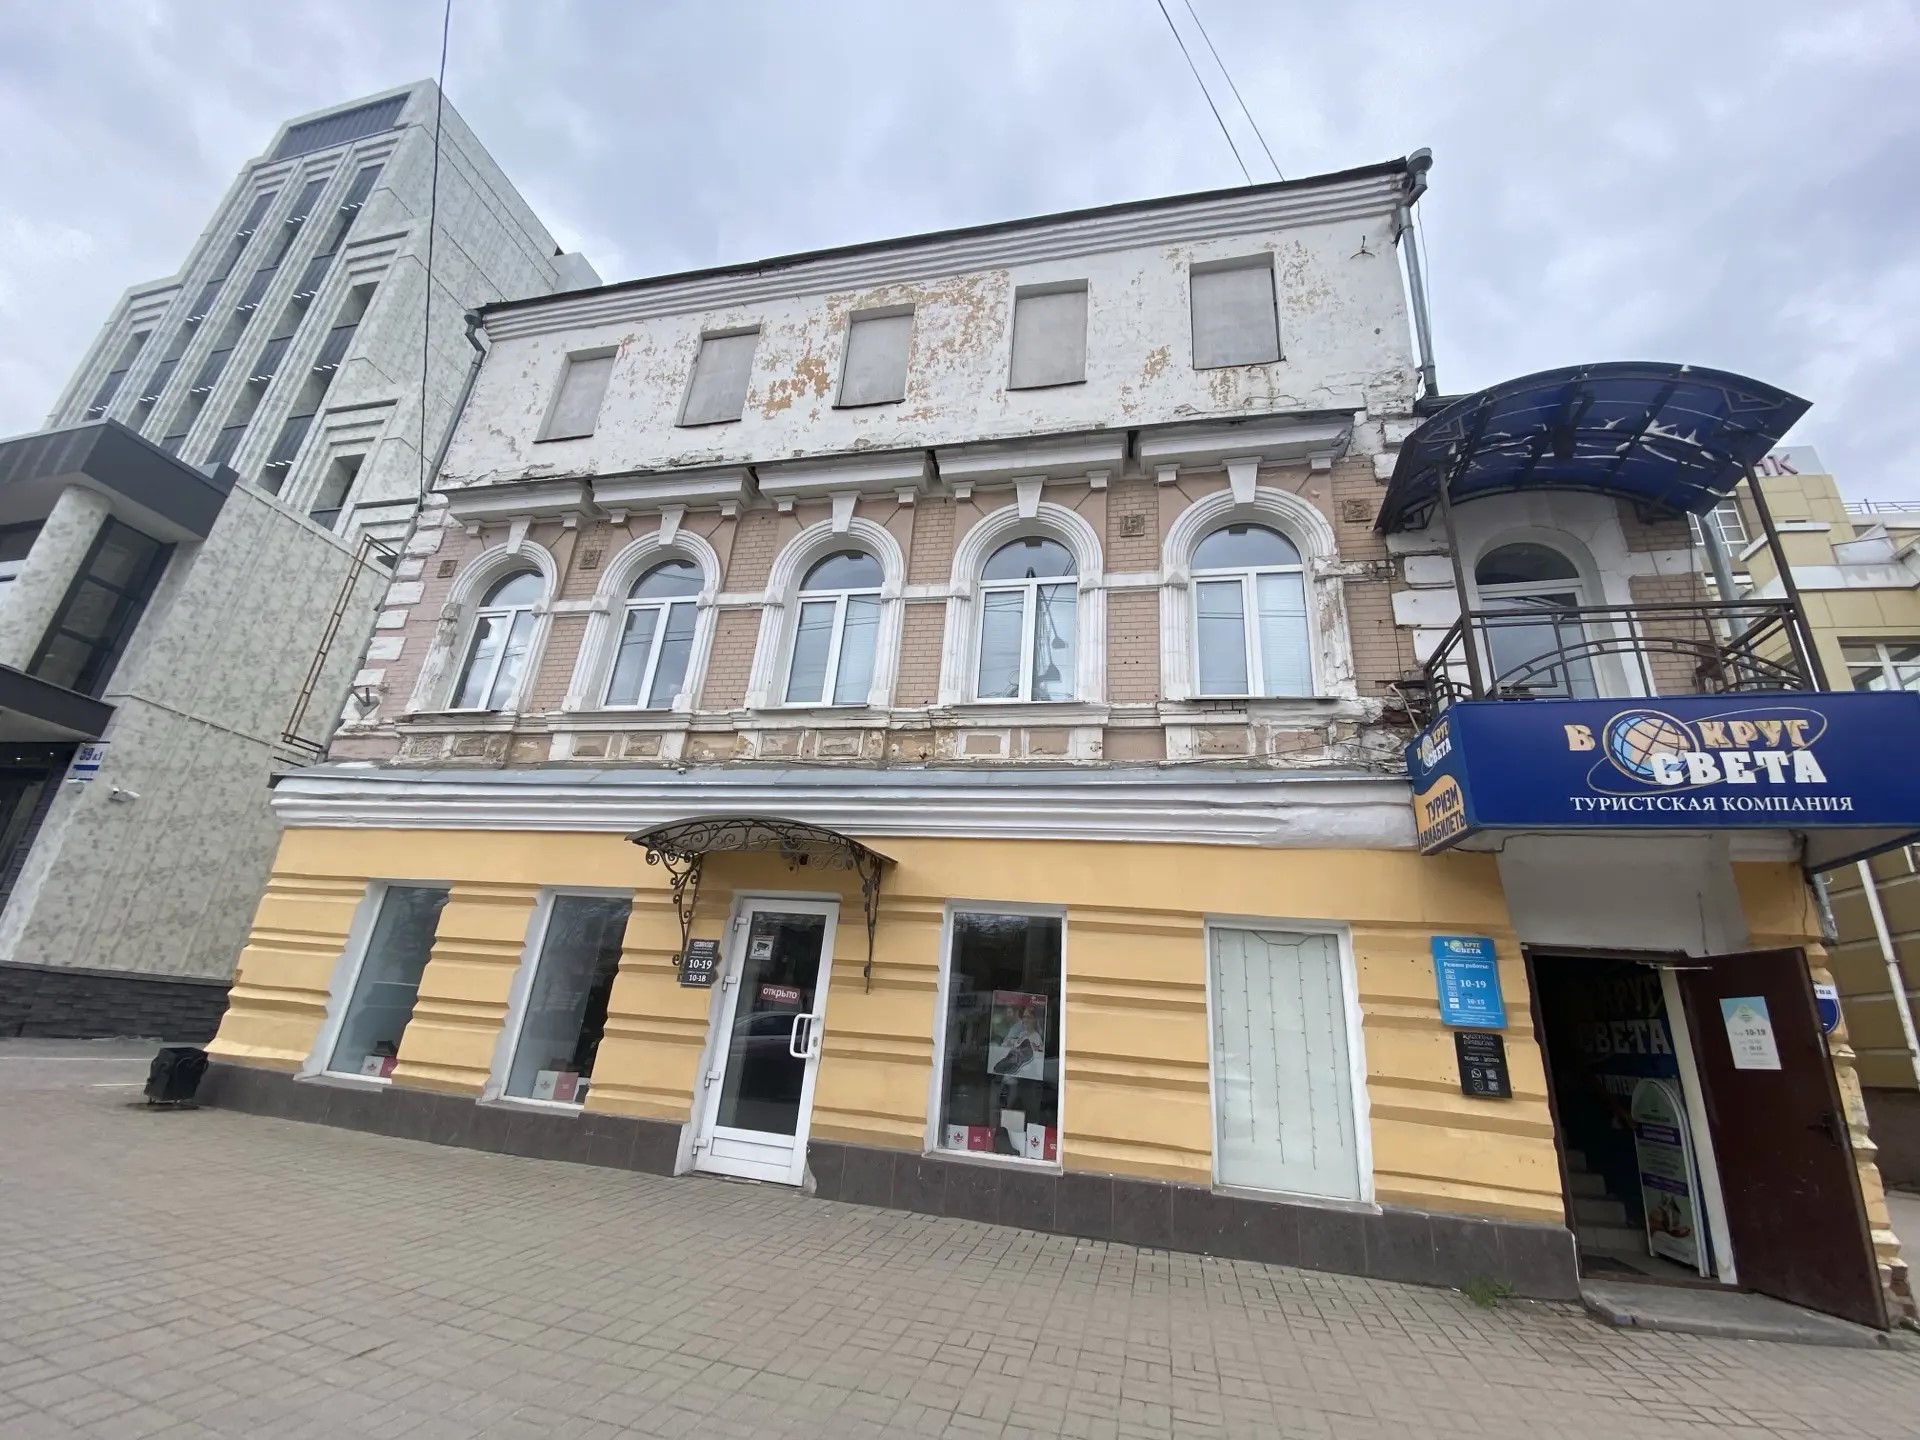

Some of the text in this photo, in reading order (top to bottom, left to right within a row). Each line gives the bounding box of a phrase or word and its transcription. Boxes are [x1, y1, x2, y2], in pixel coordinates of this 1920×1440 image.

[1650, 750, 1827, 785] СВЕТА
[1426, 784, 1459, 823] ТУРИЗМ
[1570, 796, 1854, 811] ТУРИСТСКАЯ КОМПАНИЯ
[688, 959, 713, 970] 10-19
[688, 974, 707, 983] 10-18
[1460, 979, 1487, 989] 10-19
[763, 987, 798, 999] открыто
[1577, 1018, 1673, 1055] СВЕТА
